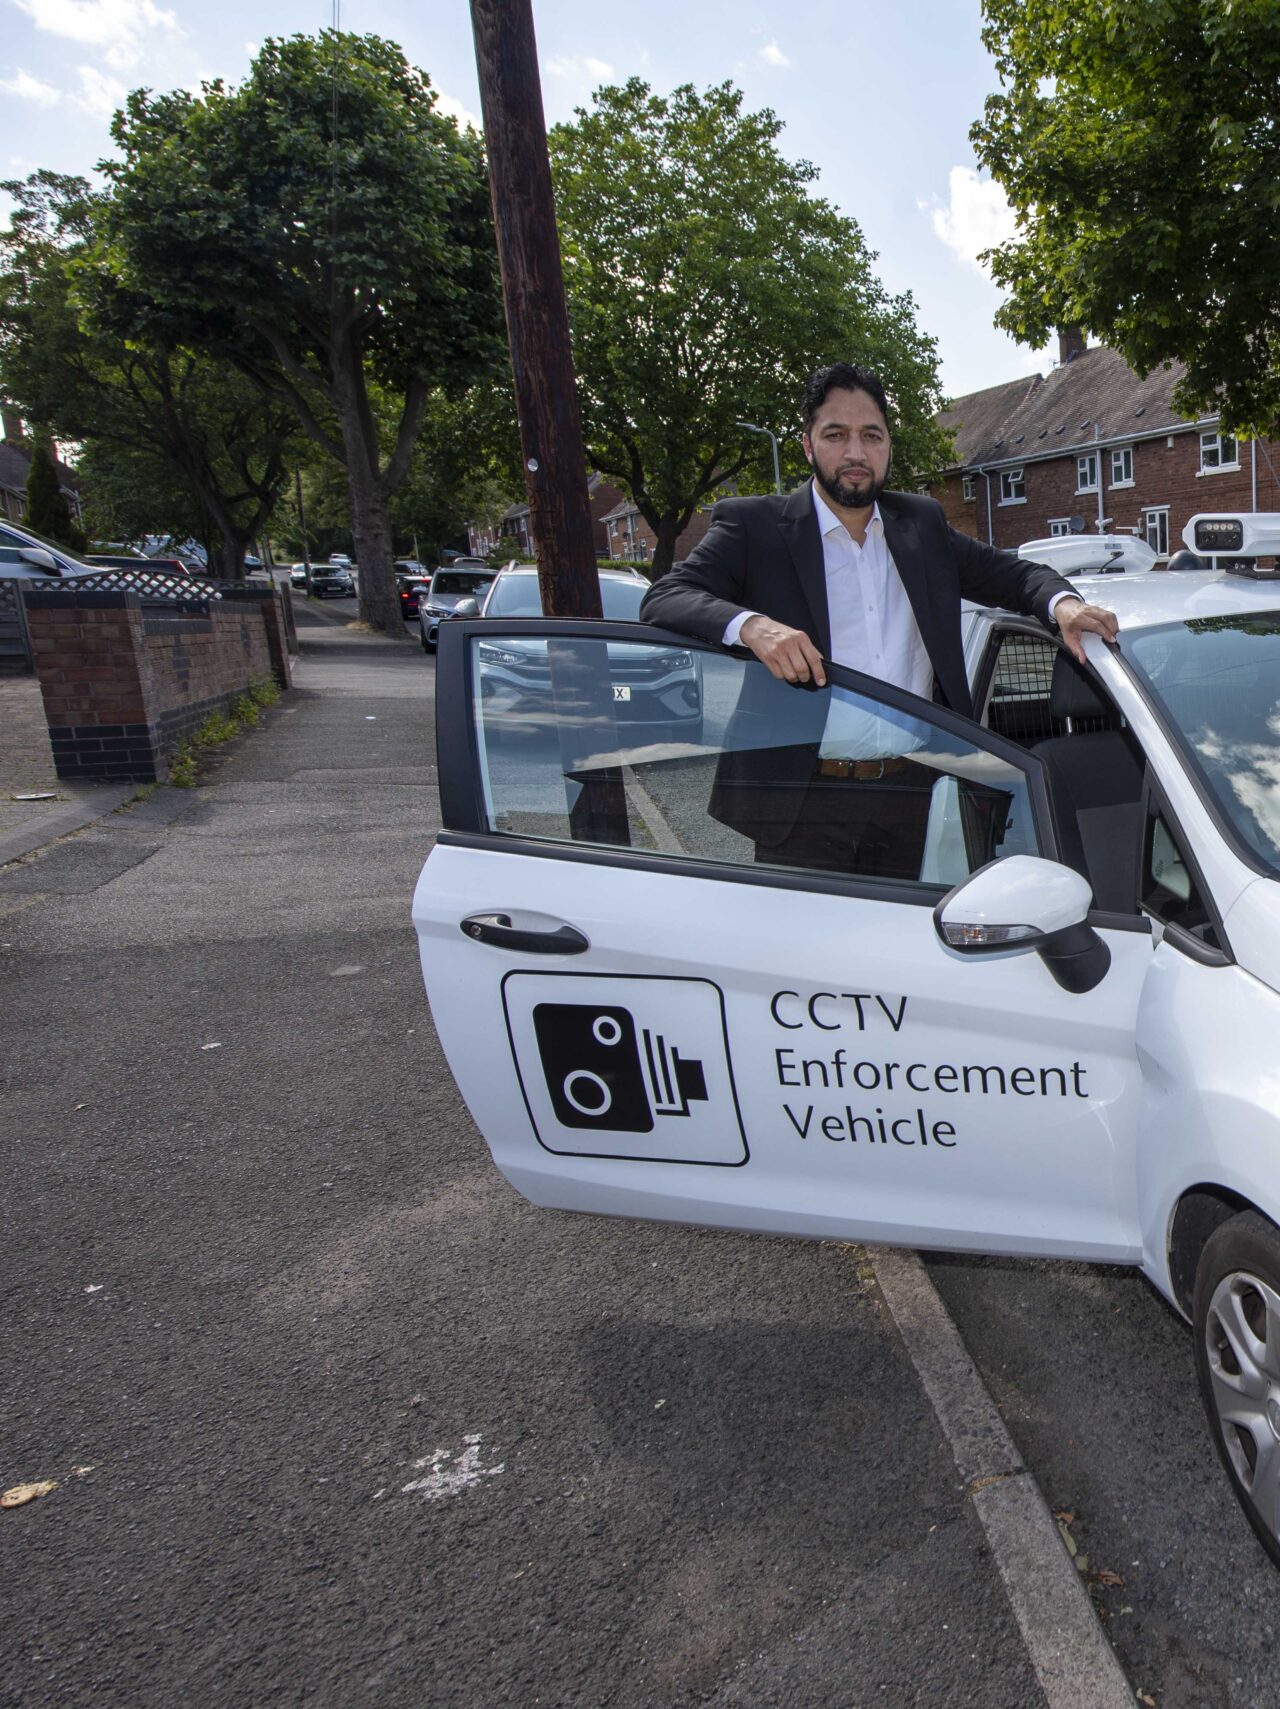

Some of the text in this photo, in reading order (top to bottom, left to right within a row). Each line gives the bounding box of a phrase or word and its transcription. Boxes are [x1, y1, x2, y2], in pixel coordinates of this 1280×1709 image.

[770, 990, 908, 1032] CCTV
[774, 1048, 1090, 1098] Enforcement
[783, 1103, 958, 1147] Vehicle
